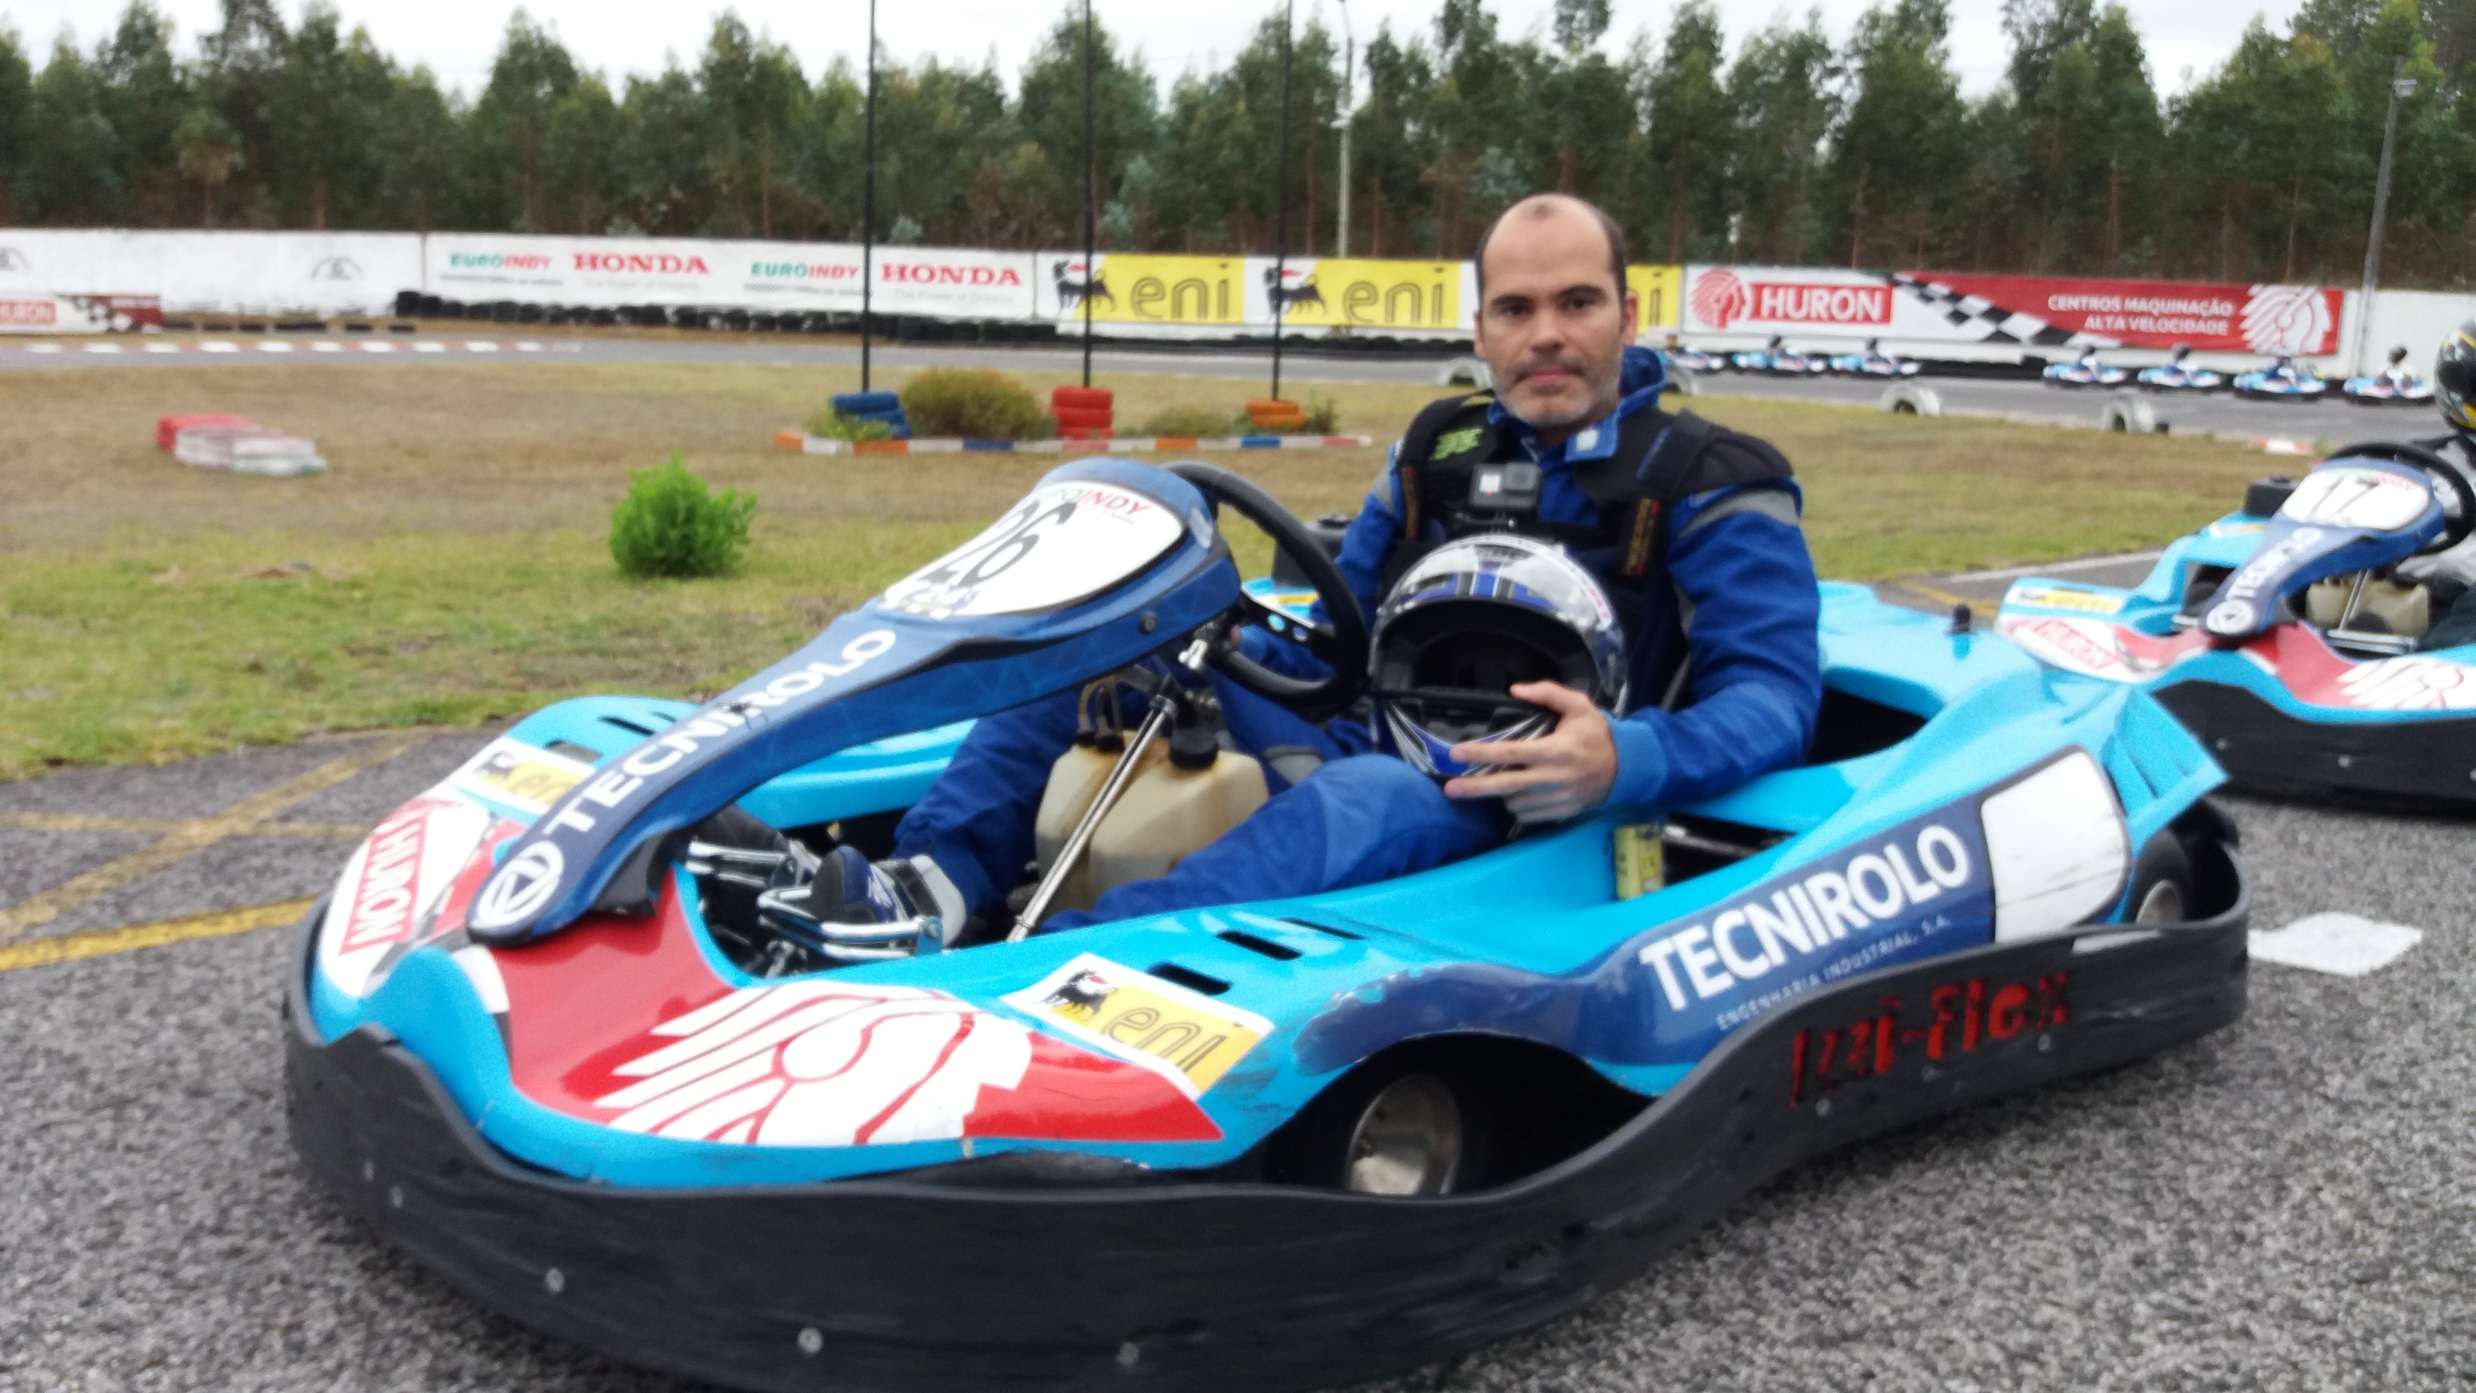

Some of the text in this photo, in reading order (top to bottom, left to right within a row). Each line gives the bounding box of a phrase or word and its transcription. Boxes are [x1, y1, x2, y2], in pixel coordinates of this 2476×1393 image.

[450, 252, 552, 271] EUROINDY
[573, 252, 709, 274] HONDA
[750, 260, 859, 280] EUROINDY
[881, 262, 1022, 287] HONDA
[1130, 261, 1229, 320] eni
[1343, 266, 1445, 324] eni
[1761, 286, 1884, 322] HURON
[2047, 294, 2235, 318] CENTROS MAQUINAÇÃO
[2084, 314, 2230, 336] ALTA VELOCIDADE
[1638, 823, 1971, 1012] TECNIROLO
[1716, 972, 1821, 1032] ENGENHARIA
[1100, 1005, 1244, 1074] eni
